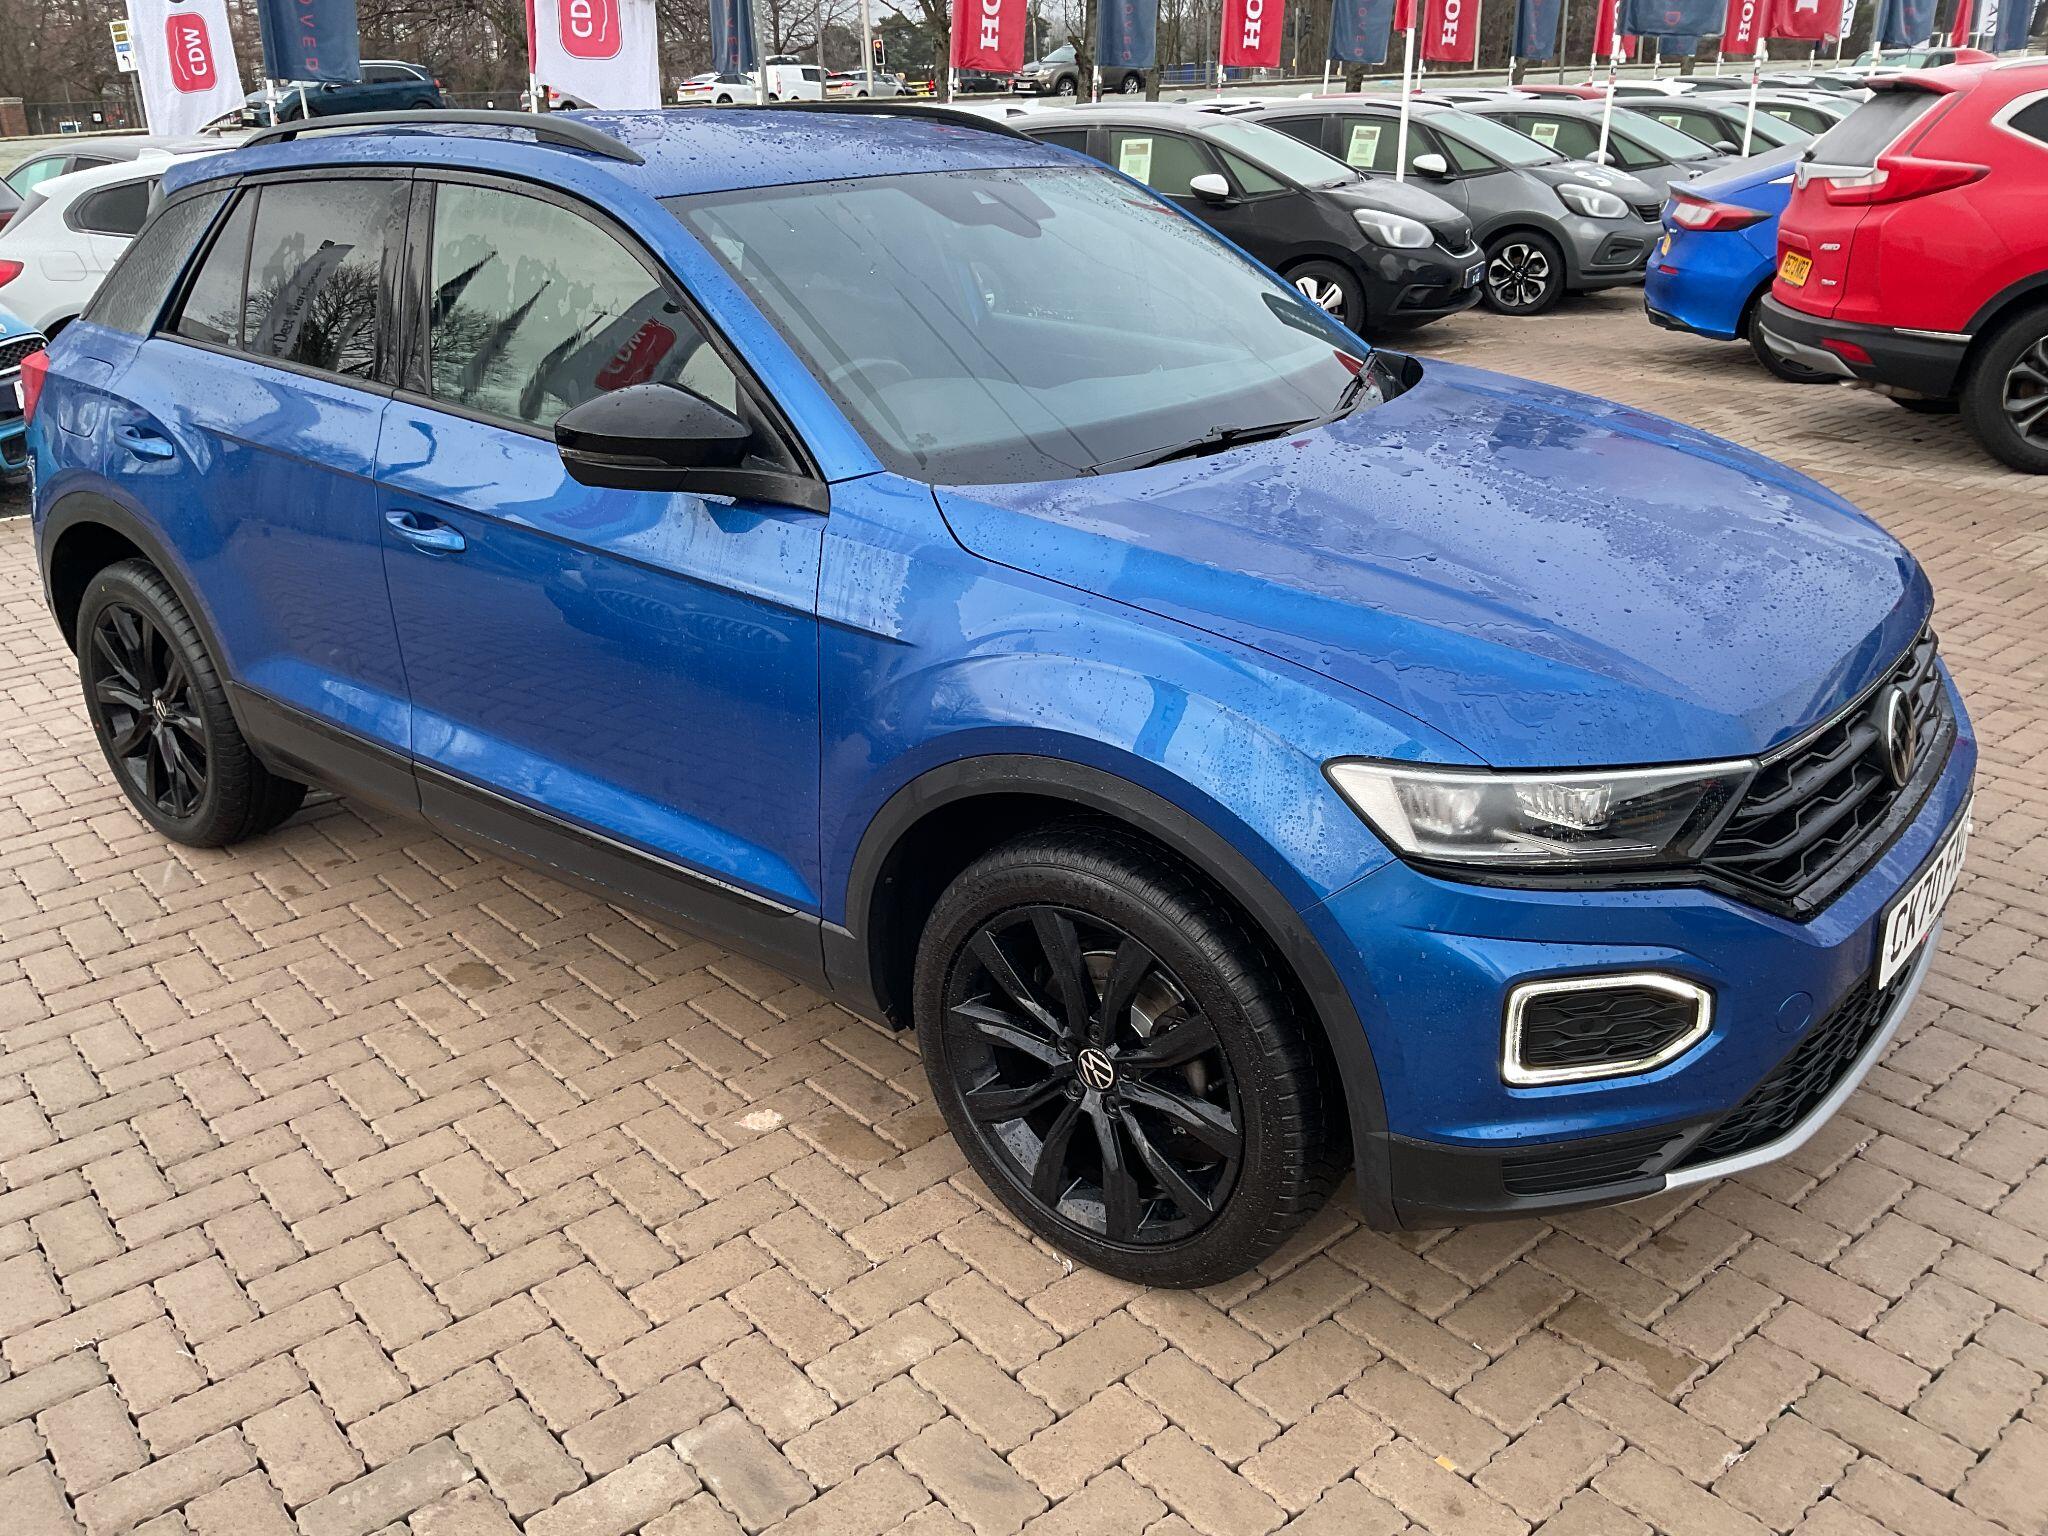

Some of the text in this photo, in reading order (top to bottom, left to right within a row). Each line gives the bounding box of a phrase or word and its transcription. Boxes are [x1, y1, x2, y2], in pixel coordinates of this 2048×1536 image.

[1242, 0, 1263, 50] HO
[1441, 0, 1461, 46] HO
[1737, 0, 1756, 42] HO
[182, 27, 208, 76] CDW
